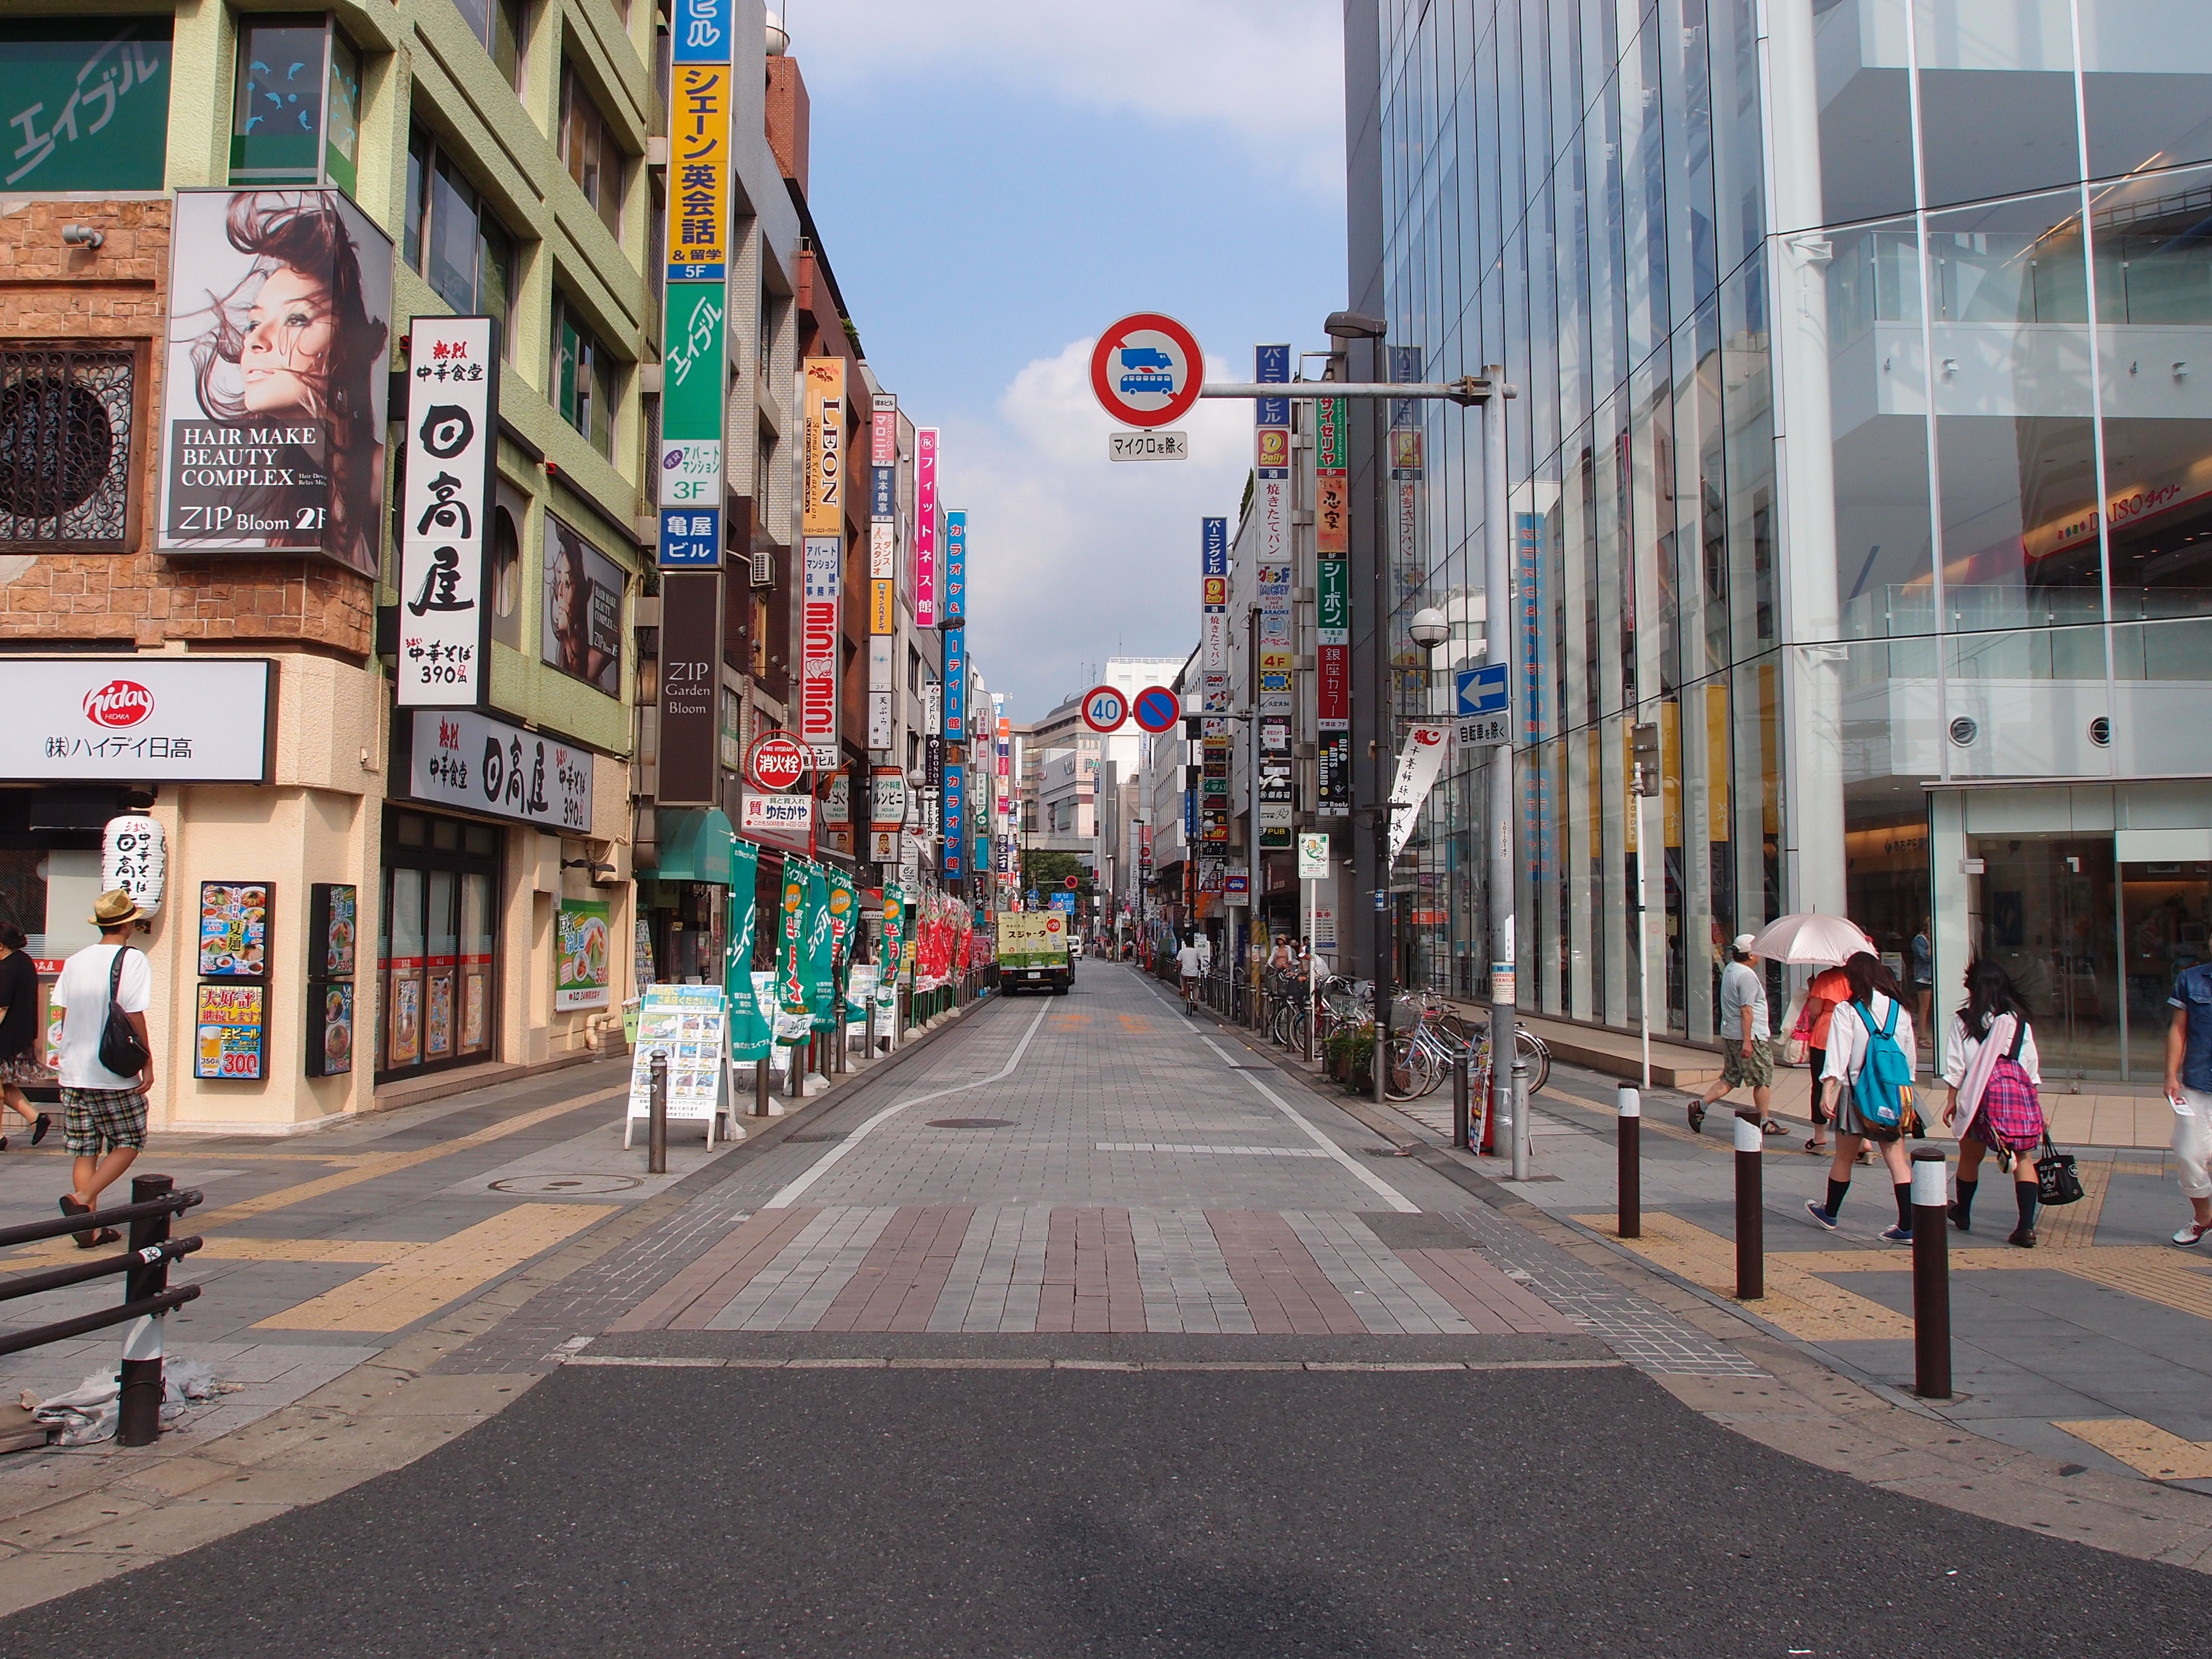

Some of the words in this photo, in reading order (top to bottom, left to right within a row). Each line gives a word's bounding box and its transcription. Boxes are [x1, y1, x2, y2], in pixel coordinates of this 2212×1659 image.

[7, 23, 159, 184] エイブル
[682, 70, 719, 244] シェーン英会話
[672, 250, 685, 261] &
[690, 249, 722, 261] 留学
[685, 265, 706, 278] 5F
[433, 340, 467, 359] 熱烈
[667, 296, 723, 386] エイブル
[416, 360, 483, 383] 中華食堂
[183, 429, 242, 445] HAIR
[249, 427, 316, 444] MAKE
[875, 415, 886, 458] マロニエ
[1321, 398, 1334, 466] サイゼリヤ
[683, 446, 720, 461] アパート
[821, 397, 842, 508] LEON
[1114, 437, 1183, 454] マイクロを除く
[182, 449, 278, 466] BEAUTY
[683, 461, 719, 474] マンション
[1261, 453, 1286, 464] Daily
[181, 469, 294, 486] COMPLEX
[1269, 470, 1278, 478] 酒
[673, 481, 708, 499] 3F
[179, 506, 233, 531] ZIP
[237, 514, 290, 531] Bloom
[295, 508, 327, 529] 2F
[407, 404, 474, 617] 日高屋
[1266, 483, 1281, 555] 焼きたてパン
[667, 515, 712, 536] 亀屋
[918, 457, 933, 614] フィットネス館
[669, 542, 710, 558] ビル
[807, 546, 836, 556] アパート
[883, 541, 891, 565] ダンス
[1208, 520, 1221, 574] バーニングビル
[807, 560, 836, 569] マンション
[873, 543, 882, 575] スタジオ
[806, 586, 835, 596] 事務所
[1259, 585, 1289, 596] MICKEY
[594, 631, 603, 648] ZIP
[806, 603, 834, 658] mini
[1210, 615, 1219, 666] 焼きたてパン
[409, 640, 474, 665] 中華そば
[1264, 655, 1285, 666] 4F
[669, 663, 708, 680] ZIP
[666, 684, 710, 695] Garden
[1326, 648, 1341, 717] 銀座カラー
[670, 702, 706, 713] Bloom
[805, 678, 833, 733] mini
[1092, 699, 1118, 720] 40
[439, 716, 458, 751] 熱烈
[1460, 722, 1504, 742] 自転車を除く
[759, 754, 799, 773] 消火栓
[1329, 742, 1338, 768] DARTS
[430, 750, 467, 788] 中華食堂
[483, 734, 548, 815] 日高屋
[559, 760, 586, 797] 中華そば
[1319, 750, 1329, 786] BILLIARD
[749, 801, 762, 816] 質
[873, 792, 902, 805] ルンビニ
[766, 805, 807, 820] ゆたかや
[947, 776, 959, 870] カラオケ館
[136, 832, 152, 893] 中華そば
[559, 912, 574, 936] 豆乳
[808, 905, 831, 962] エイブル
[884, 922, 900, 980] 半月分
[201, 990, 255, 1008] 大好評
[220, 1027, 260, 1040] 生ビール
